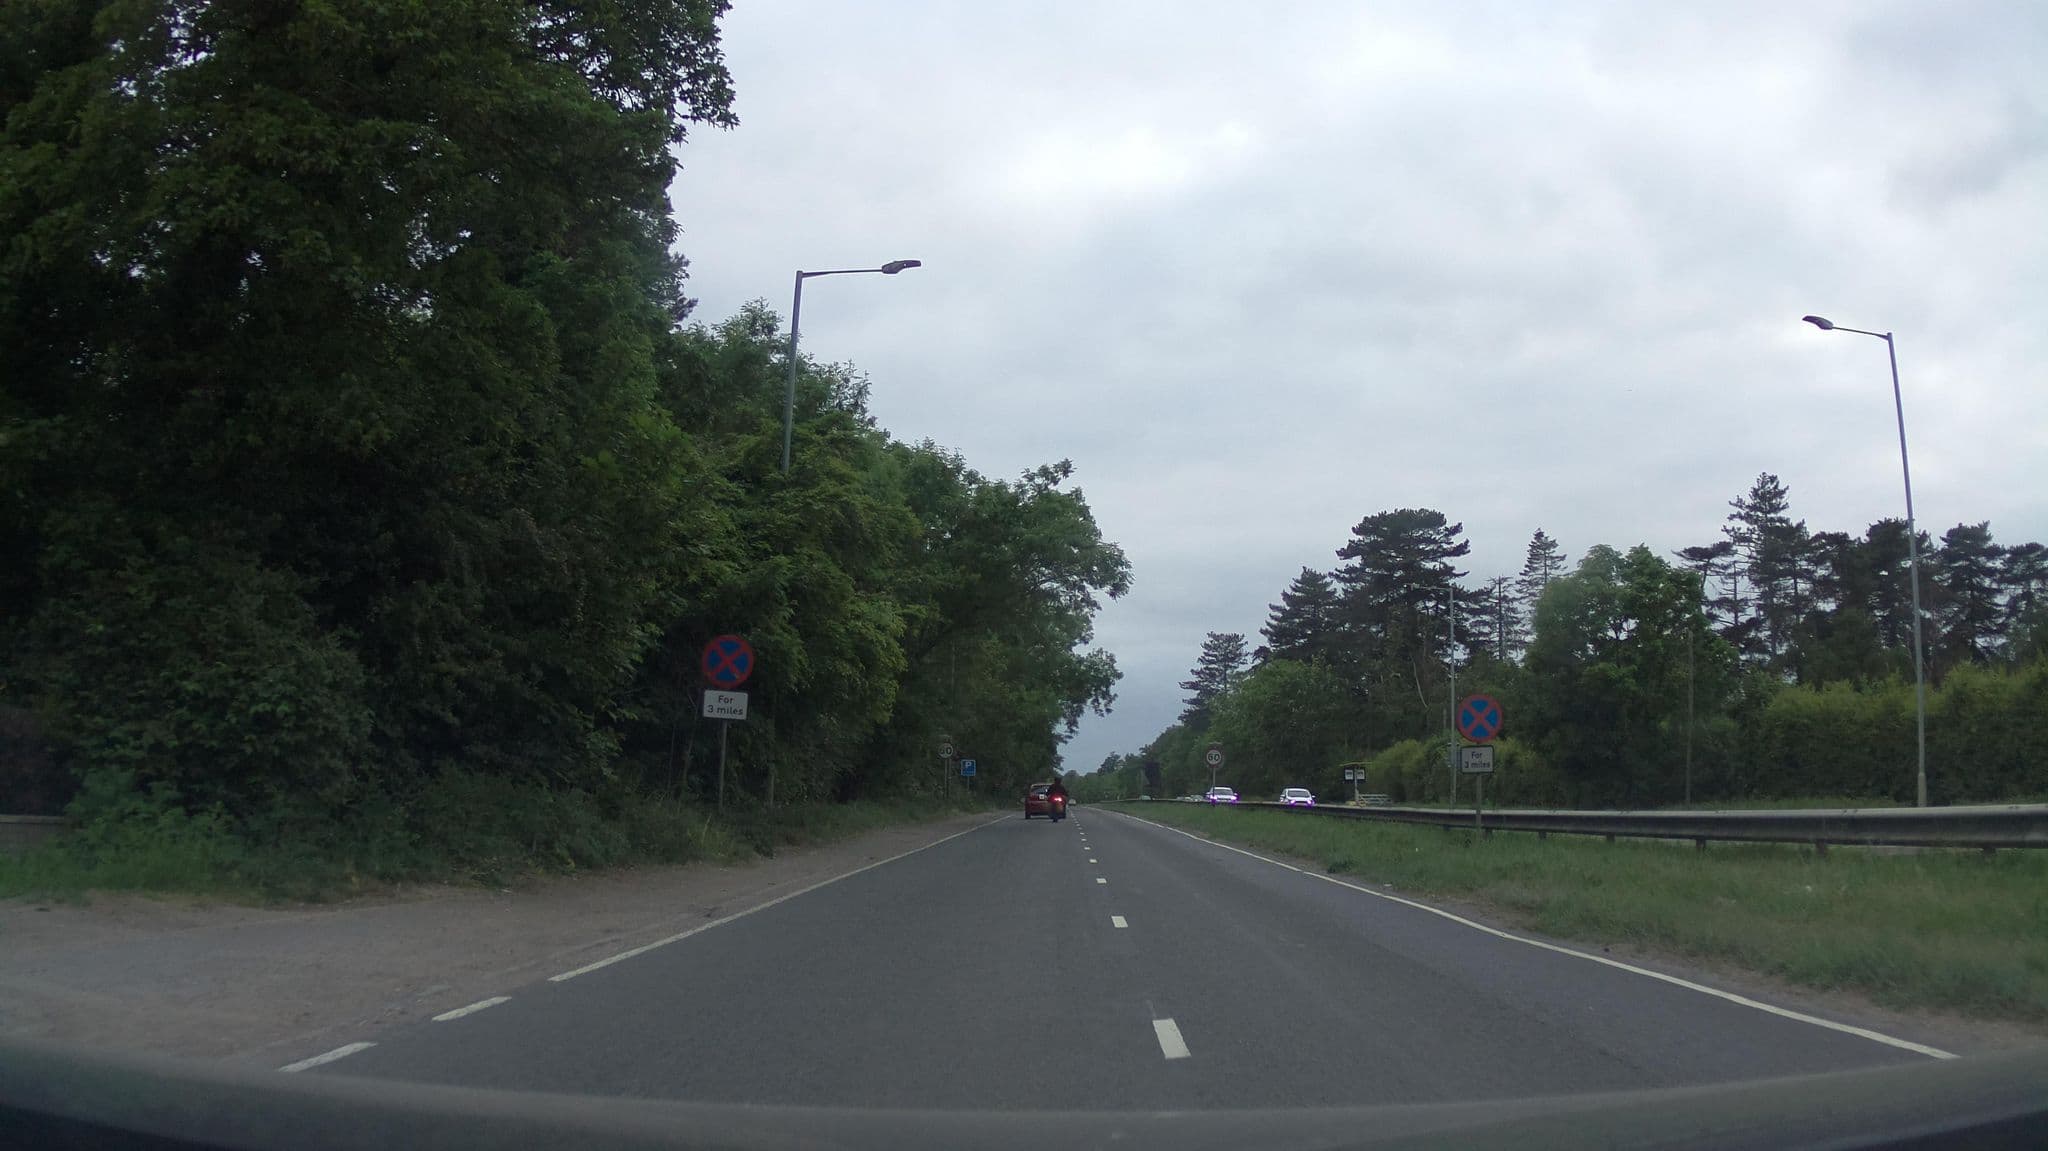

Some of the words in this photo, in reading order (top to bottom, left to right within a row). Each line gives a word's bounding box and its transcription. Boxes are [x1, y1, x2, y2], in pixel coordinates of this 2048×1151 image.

[718, 695, 735, 704] For
[707, 704, 714, 713] 3
[716, 706, 744, 716] miles
[1471, 751, 1483, 759] For
[1470, 760, 1491, 769] miles
